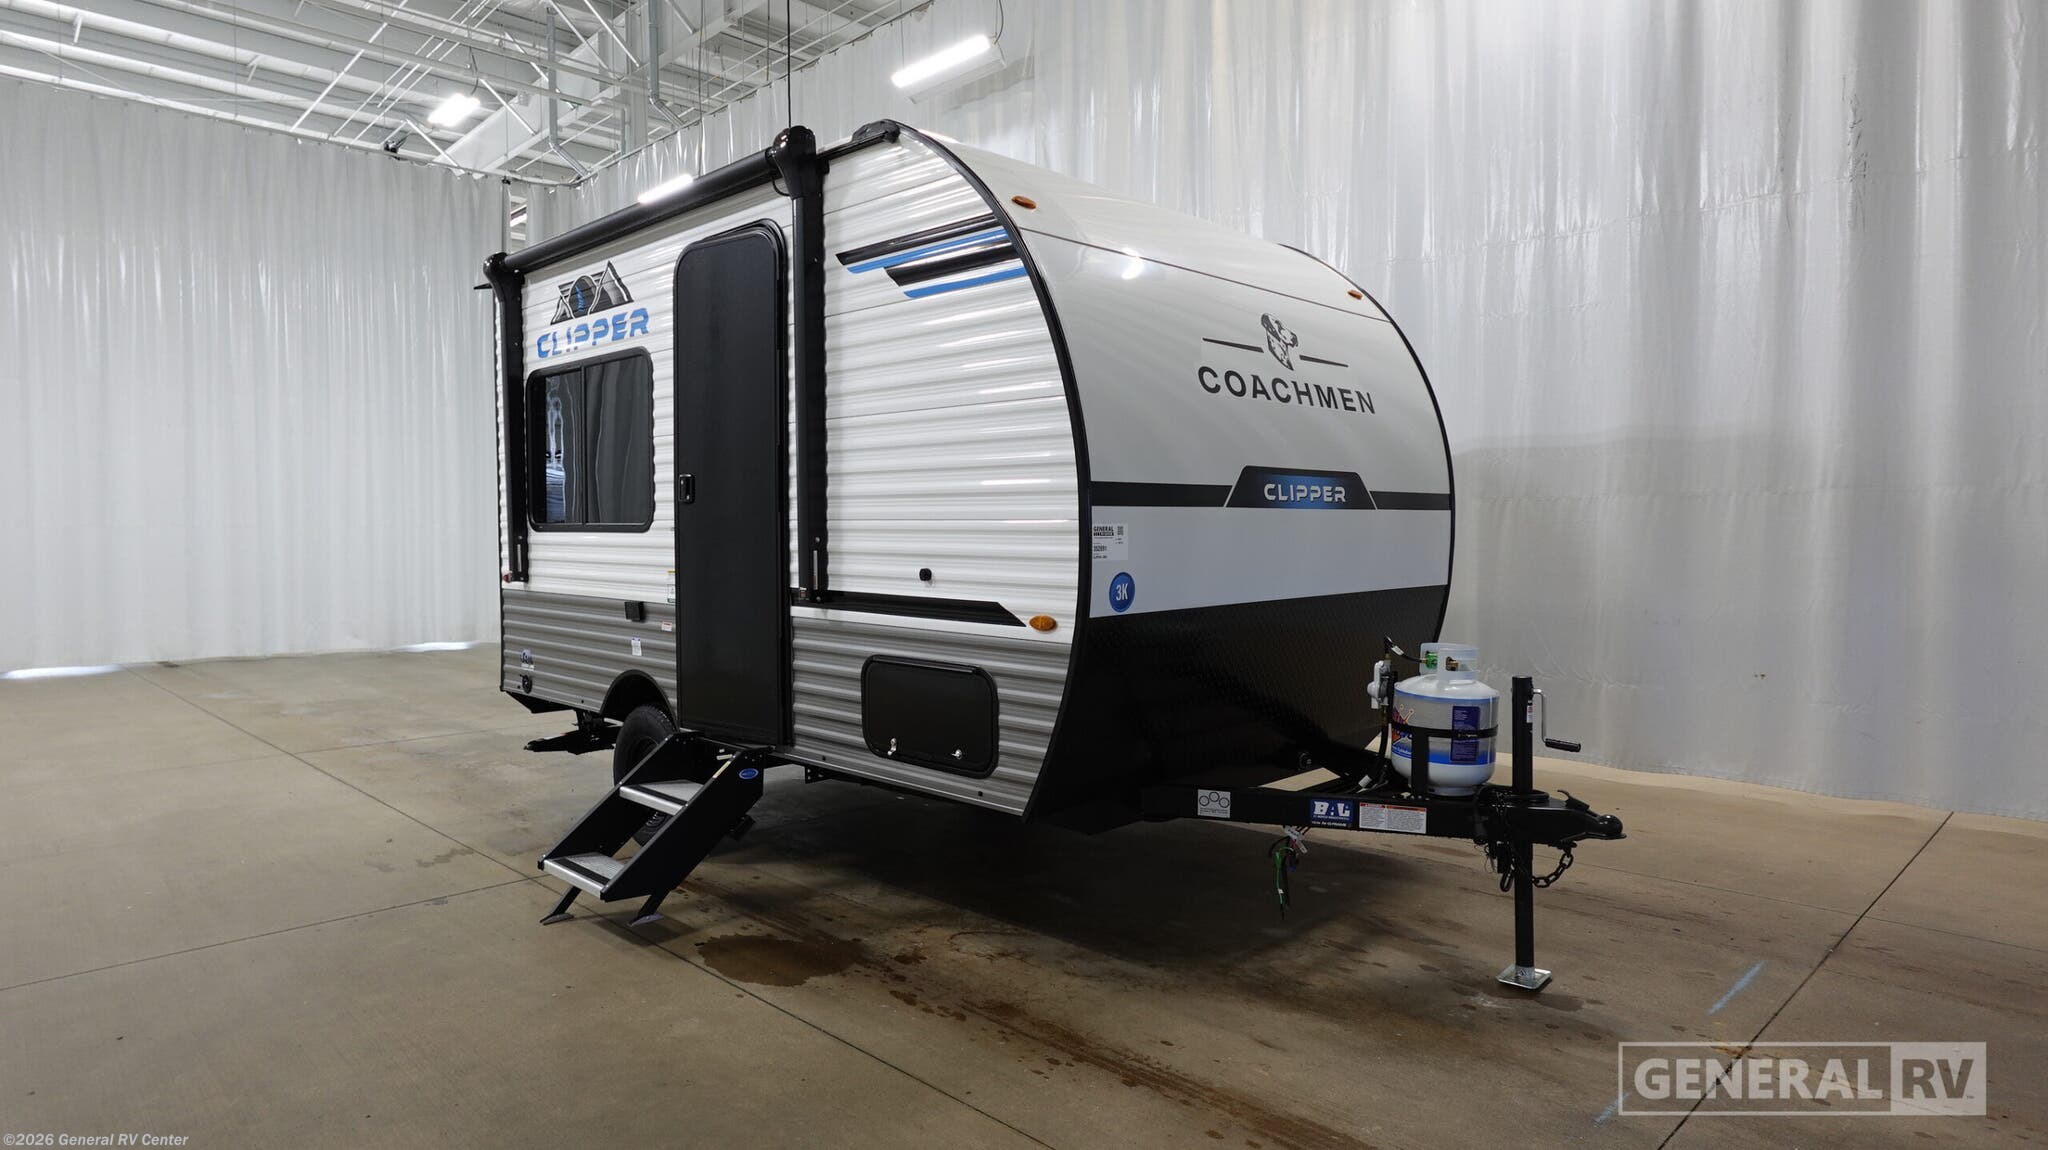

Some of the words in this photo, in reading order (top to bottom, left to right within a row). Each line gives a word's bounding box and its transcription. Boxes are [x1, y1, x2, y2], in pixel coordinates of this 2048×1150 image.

[537, 308, 649, 358] CLIPPER
[1198, 366, 1376, 414] COACHMEN
[1263, 483, 1346, 502] CLIPPER
[1115, 583, 1128, 601] 3K
